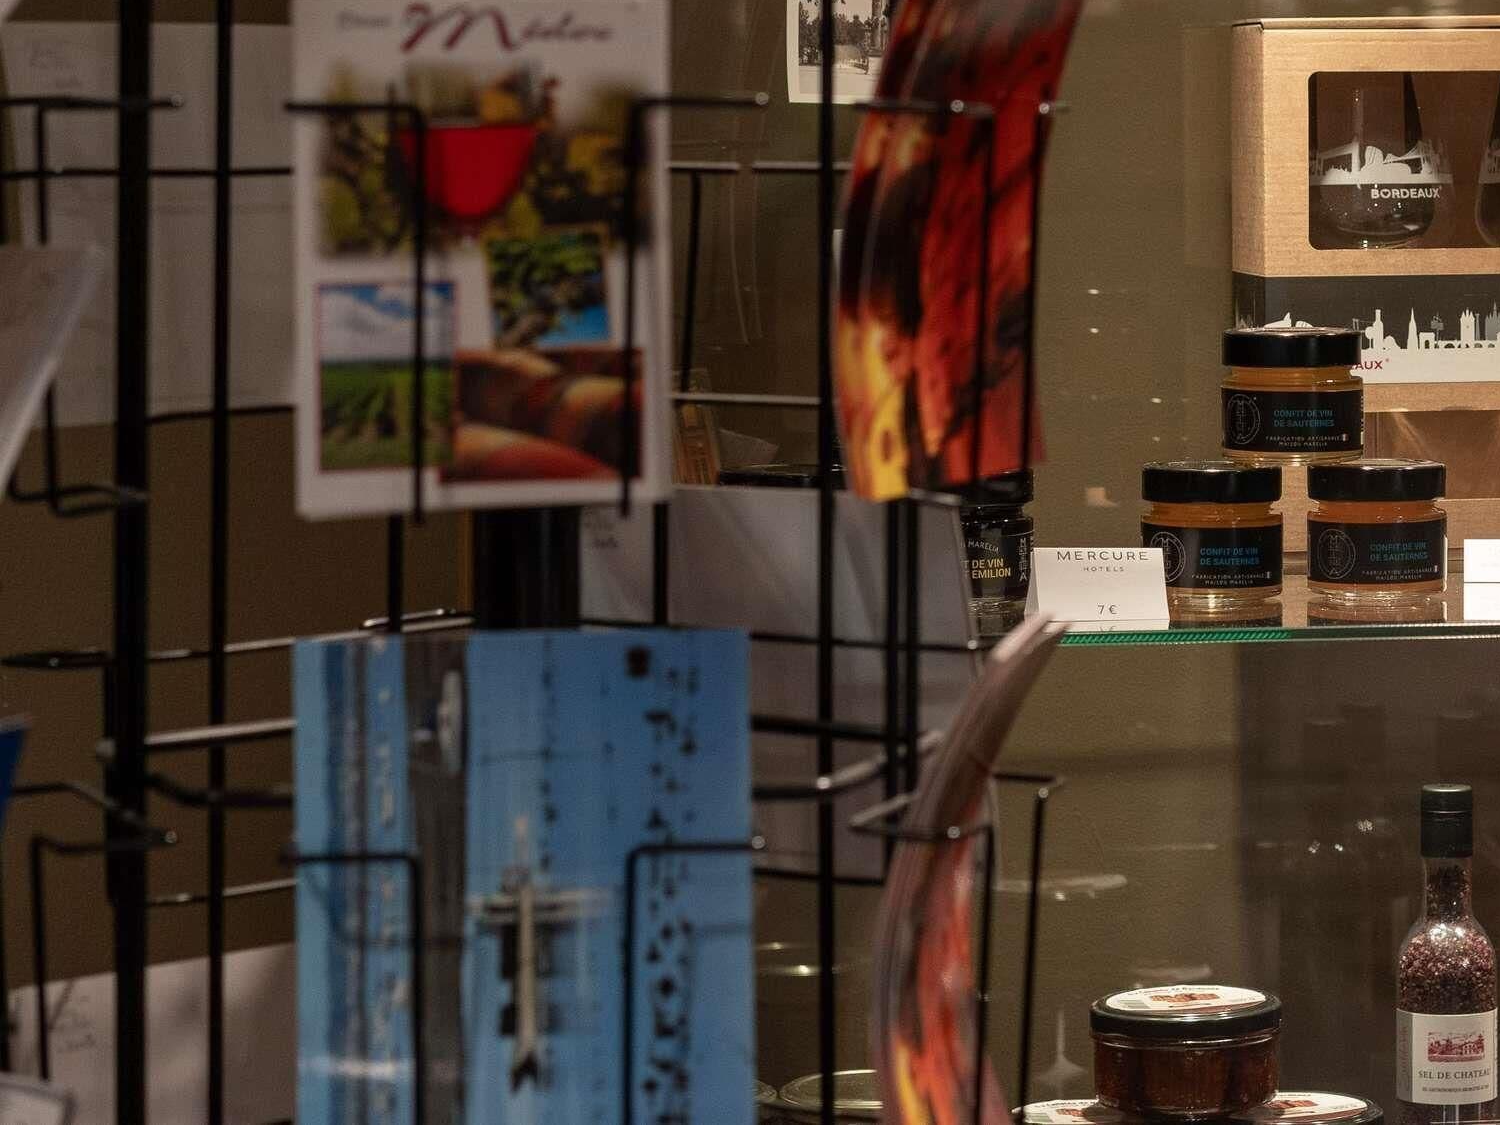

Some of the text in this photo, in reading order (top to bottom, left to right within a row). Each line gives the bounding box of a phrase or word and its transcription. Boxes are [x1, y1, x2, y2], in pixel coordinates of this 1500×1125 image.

[1370, 186, 1440, 200] BORDEAUX
[1056, 550, 1150, 562] MERCURE
[1199, 547, 1231, 556] CONFIT
[971, 559, 985, 569] DE
[987, 558, 1004, 568] VIN
[1199, 557, 1210, 566] DE
[1097, 604, 1118, 615] 7 €
[1418, 1070, 1435, 1079] SEL
[1437, 1071, 1452, 1079] DE
